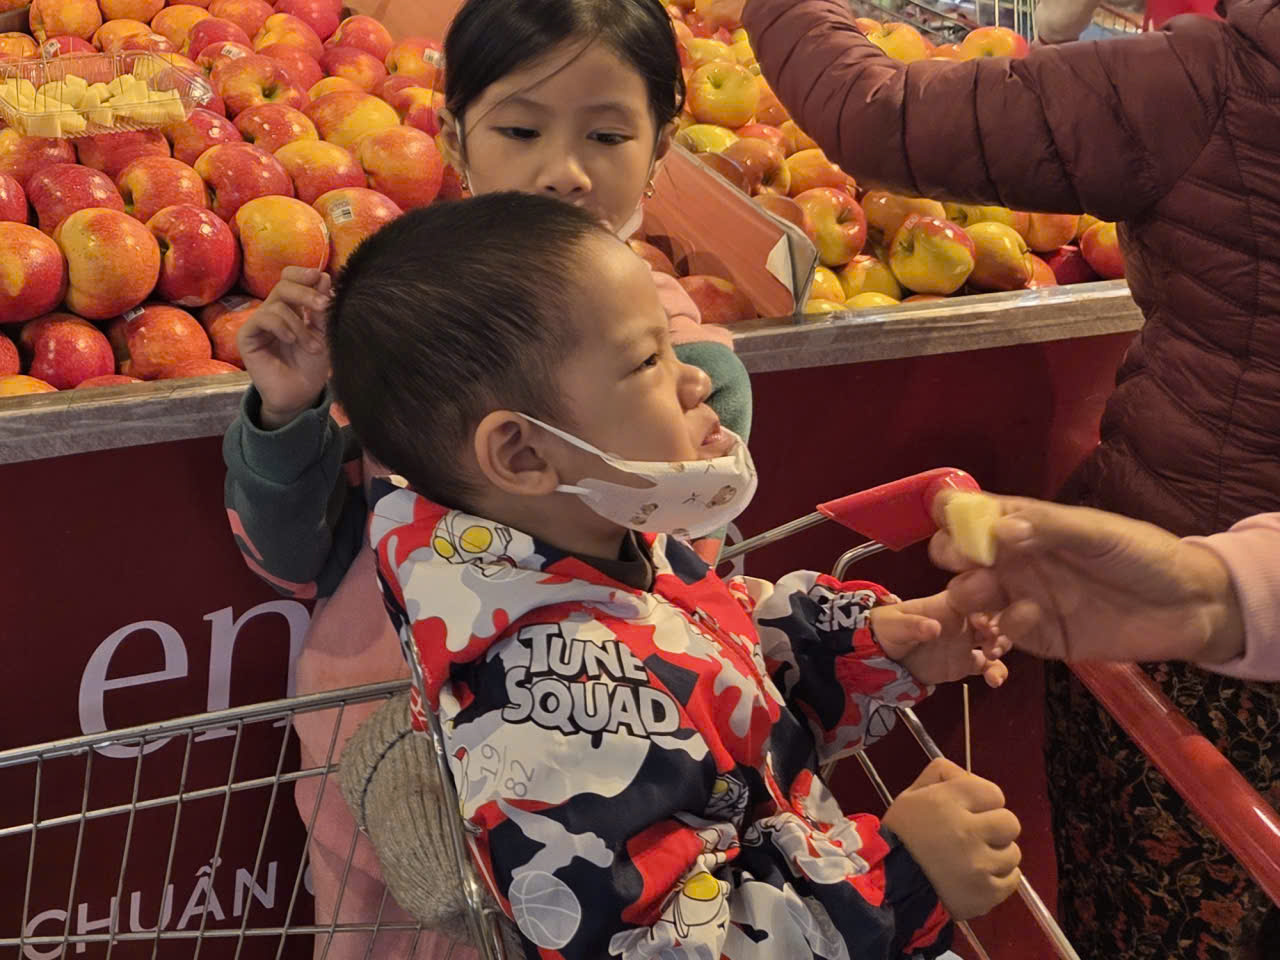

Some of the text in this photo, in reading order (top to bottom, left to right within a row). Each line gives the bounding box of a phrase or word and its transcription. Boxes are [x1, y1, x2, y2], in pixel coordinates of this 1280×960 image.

[518, 623, 650, 683] TUNE
[501, 665, 681, 736] SQUAD
[22, 856, 278, 960] CHUẨN
